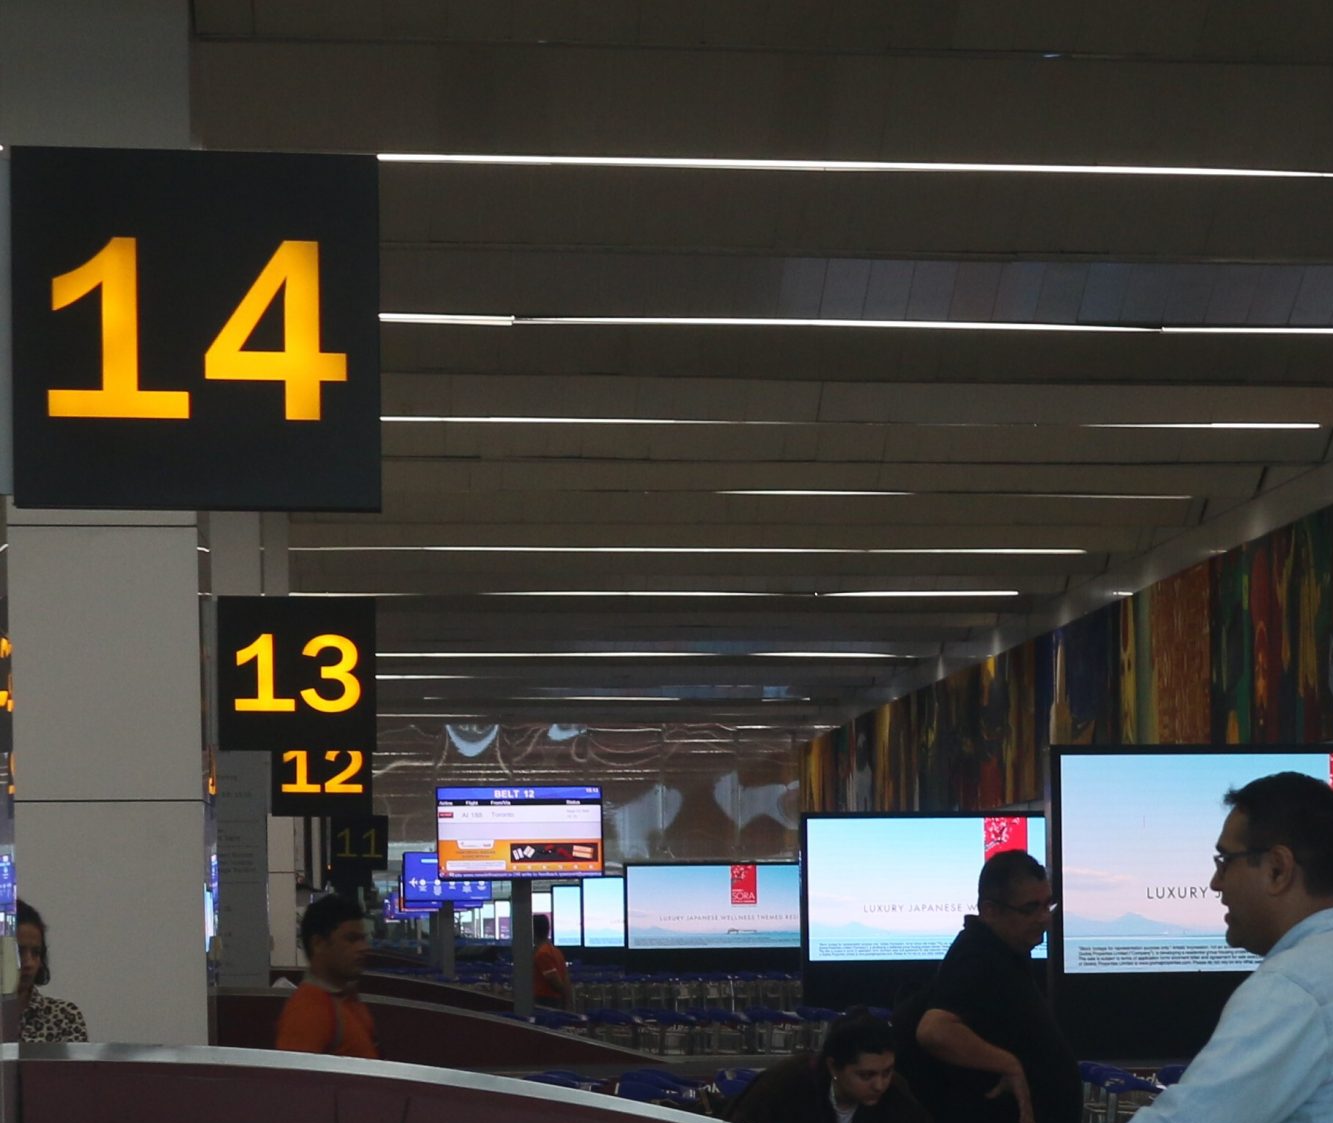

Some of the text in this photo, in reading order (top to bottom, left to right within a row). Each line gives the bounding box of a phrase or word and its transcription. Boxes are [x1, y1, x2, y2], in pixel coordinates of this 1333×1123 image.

[48, 236, 347, 421] 14
[233, 634, 361, 713] 13
[282, 750, 363, 793] 12
[494, 789, 536, 799] BELT 12
[337, 828, 383, 859] 11
[733, 891, 756, 901] SORA
[1146, 886, 1208, 900] LUXURY
[863, 903, 963, 914] LUXURY JAPANESE
